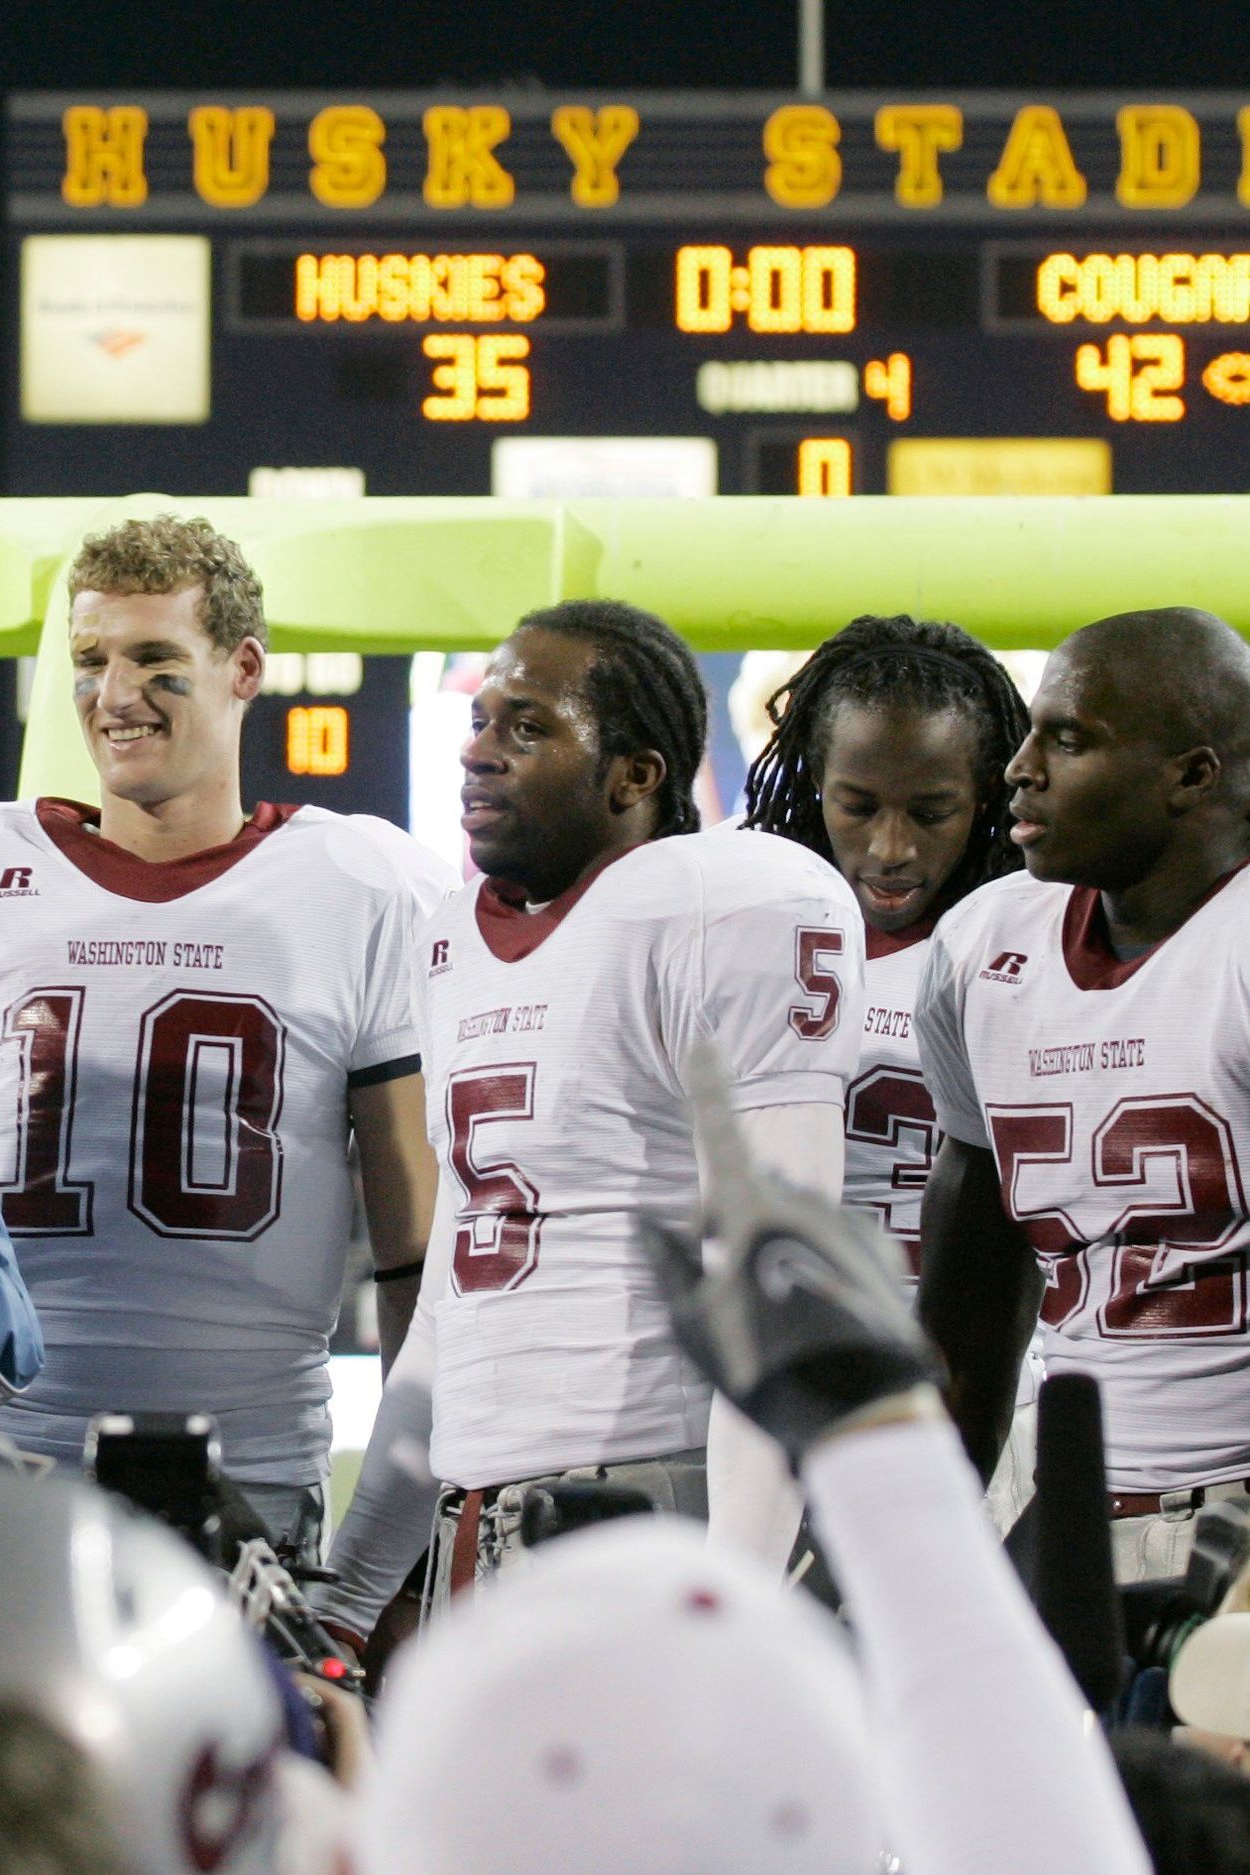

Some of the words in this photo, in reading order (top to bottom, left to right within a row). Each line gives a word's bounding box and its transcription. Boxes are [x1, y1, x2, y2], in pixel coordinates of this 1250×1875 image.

[61, 104, 639, 208] HUSKY
[763, 104, 1250, 208] STAD
[294, 254, 546, 322] HUSKIES
[675, 245, 855, 333] 0:00
[422, 334, 530, 421] 35
[864, 352, 911, 422] 4
[1076, 333, 1186, 422] 42
[285, 705, 349, 777] 10
[66, 940, 168, 966] WASHINGTON
[173, 943, 224, 970] STATE
[788, 925, 846, 1042] 5
[864, 1006, 912, 1039] STATE
[1029, 1043, 1096, 1077] WASHINGTON
[1101, 1038, 1147, 1070] STATE
[445, 1061, 548, 1299] 5
[985, 1092, 1249, 1340] 52
